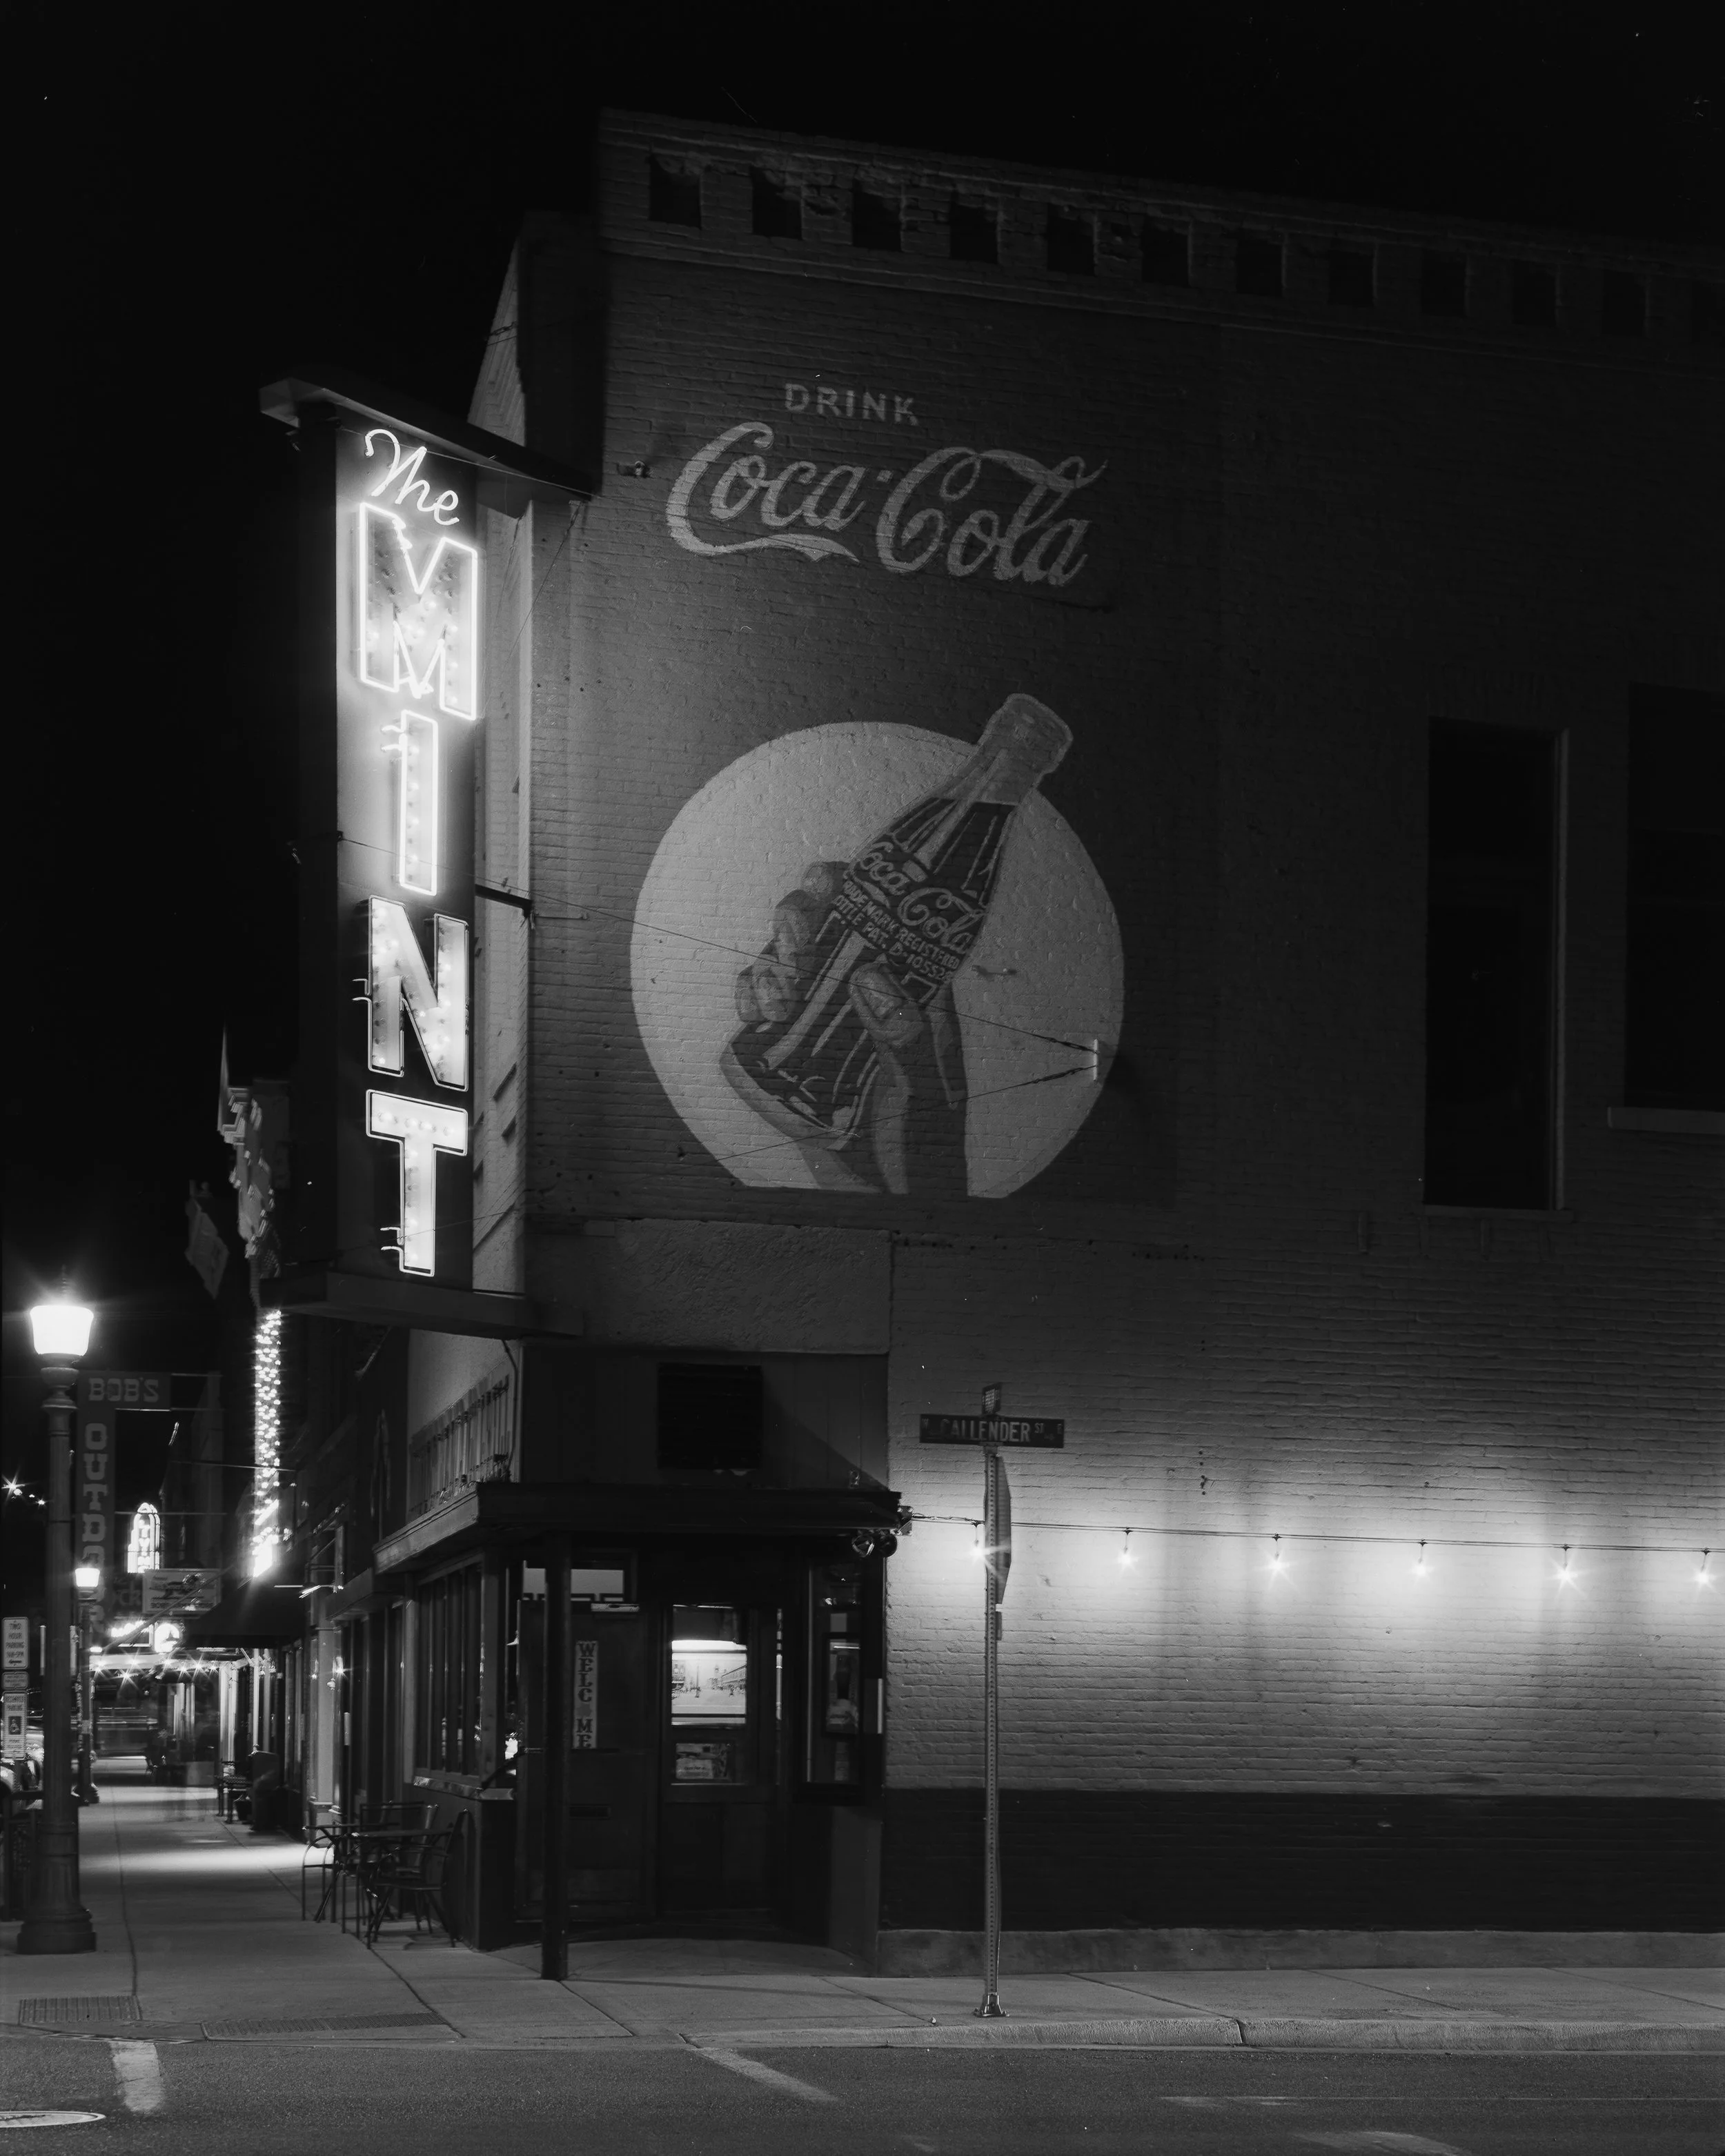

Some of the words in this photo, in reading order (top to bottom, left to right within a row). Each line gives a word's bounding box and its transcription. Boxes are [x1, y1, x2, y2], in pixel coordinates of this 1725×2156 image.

[784, 382, 920, 426] DRINK
[364, 428, 460, 526] The
[359, 502, 477, 1278] MINT
[88, 1376, 159, 1403] BOB'S
[940, 1418, 1031, 1443] CALLENDER
